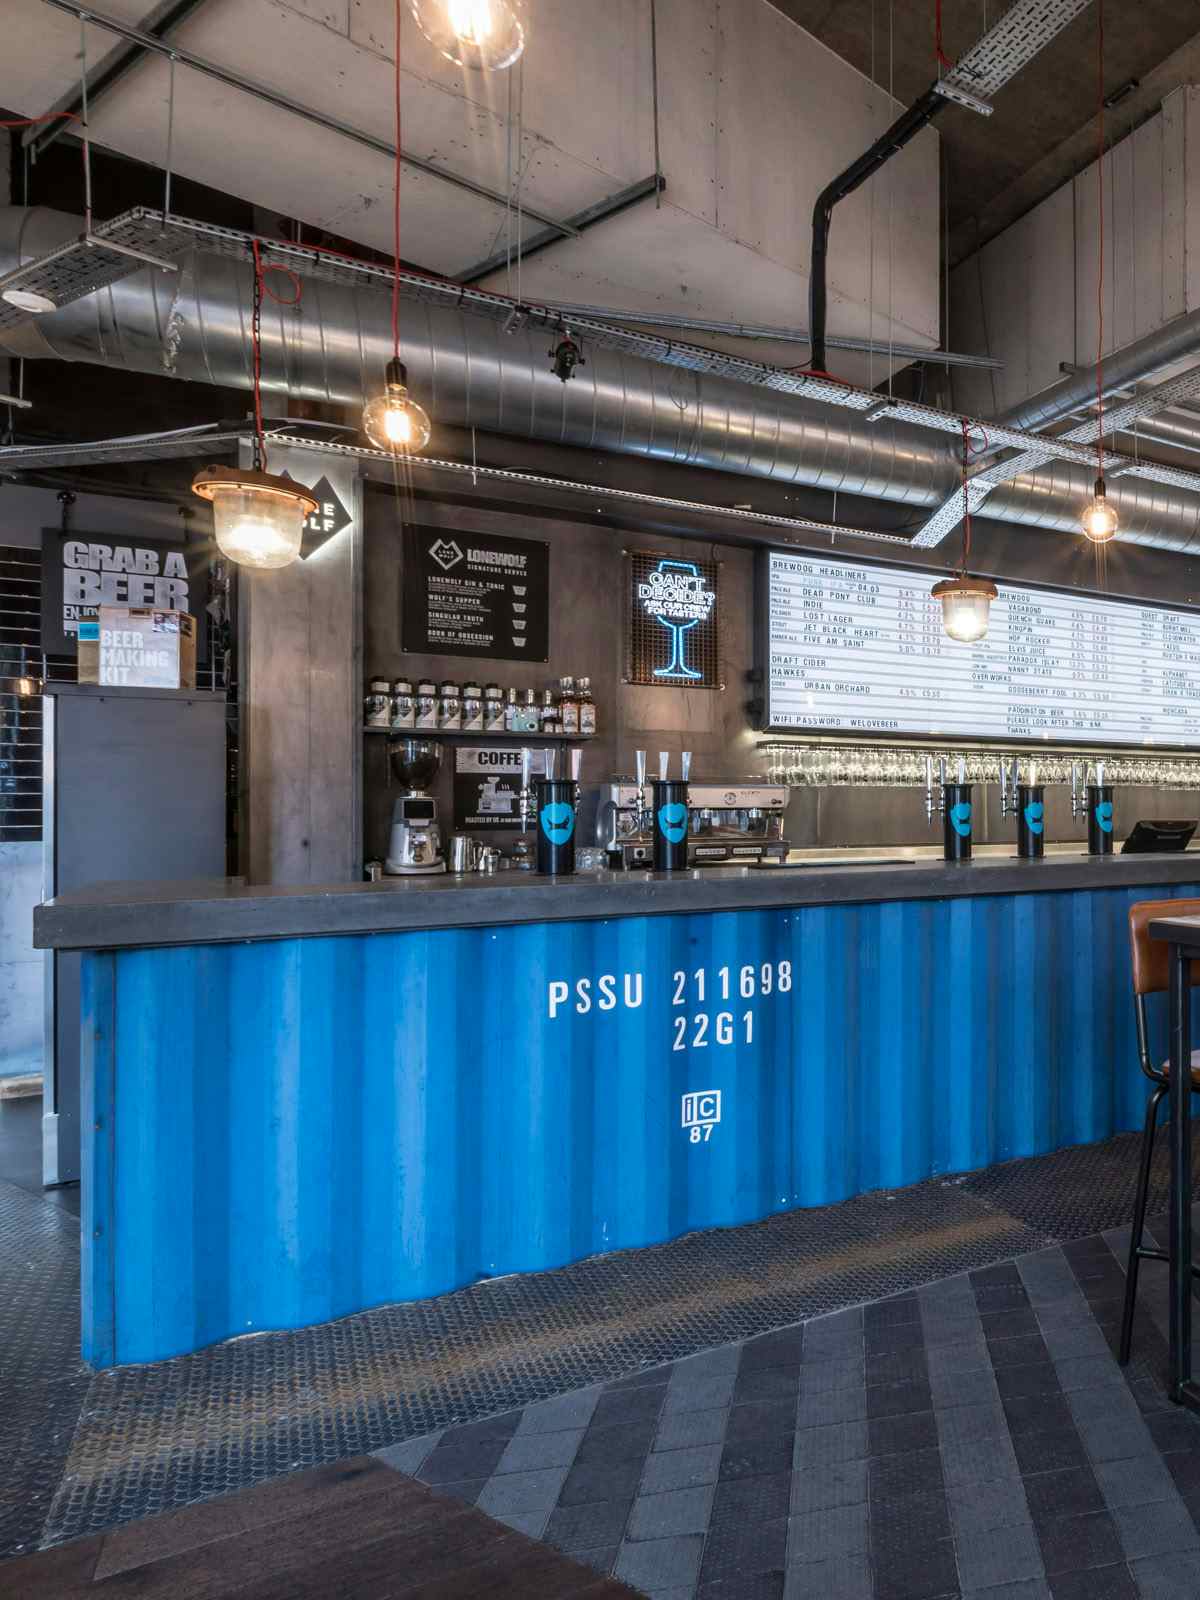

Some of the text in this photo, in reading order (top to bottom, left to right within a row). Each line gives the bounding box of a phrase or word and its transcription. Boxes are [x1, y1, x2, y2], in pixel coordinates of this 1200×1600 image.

[302, 516, 335, 532] LF
[63, 541, 189, 579] GRAB A
[467, 548, 527, 569] LONEWOLF
[772, 560, 867, 580] BREWDOG HEADLINERS
[428, 576, 462, 585] LONEWOLF
[649, 572, 706, 592] CAN'T
[63, 568, 189, 613] BEER
[639, 584, 716, 606] DECIDE?
[803, 588, 824, 597] DEAD
[830, 592, 850, 600] PONY
[857, 595, 876, 604] CLUB
[644, 600, 711, 613] ASK OUR CREW
[648, 607, 667, 616] FOR
[803, 600, 823, 609] INDIE
[803, 612, 824, 620] LOST
[828, 615, 853, 624] LAGER
[804, 623, 817, 631] JET
[823, 625, 847, 634] BLACK
[854, 629, 879, 637] HEART
[101, 630, 144, 648] BEER
[803, 635, 821, 644] FIVE
[843, 639, 865, 647] SAINT
[101, 649, 169, 667] MAKING
[772, 657, 826, 667] DRAFT CIDER
[101, 667, 131, 684] KIT
[772, 668, 806, 677] HAWKES
[804, 682, 831, 691] URBAN
[835, 684, 870, 693] ORCHARD
[773, 715, 899, 728] WIFI PASSWORD WELOVEBEER
[478, 751, 523, 766] COFFE
[548, 960, 792, 1019] PSSU 211698
[672, 1010, 753, 1051] 22G1
[689, 1124, 715, 1144] 87
